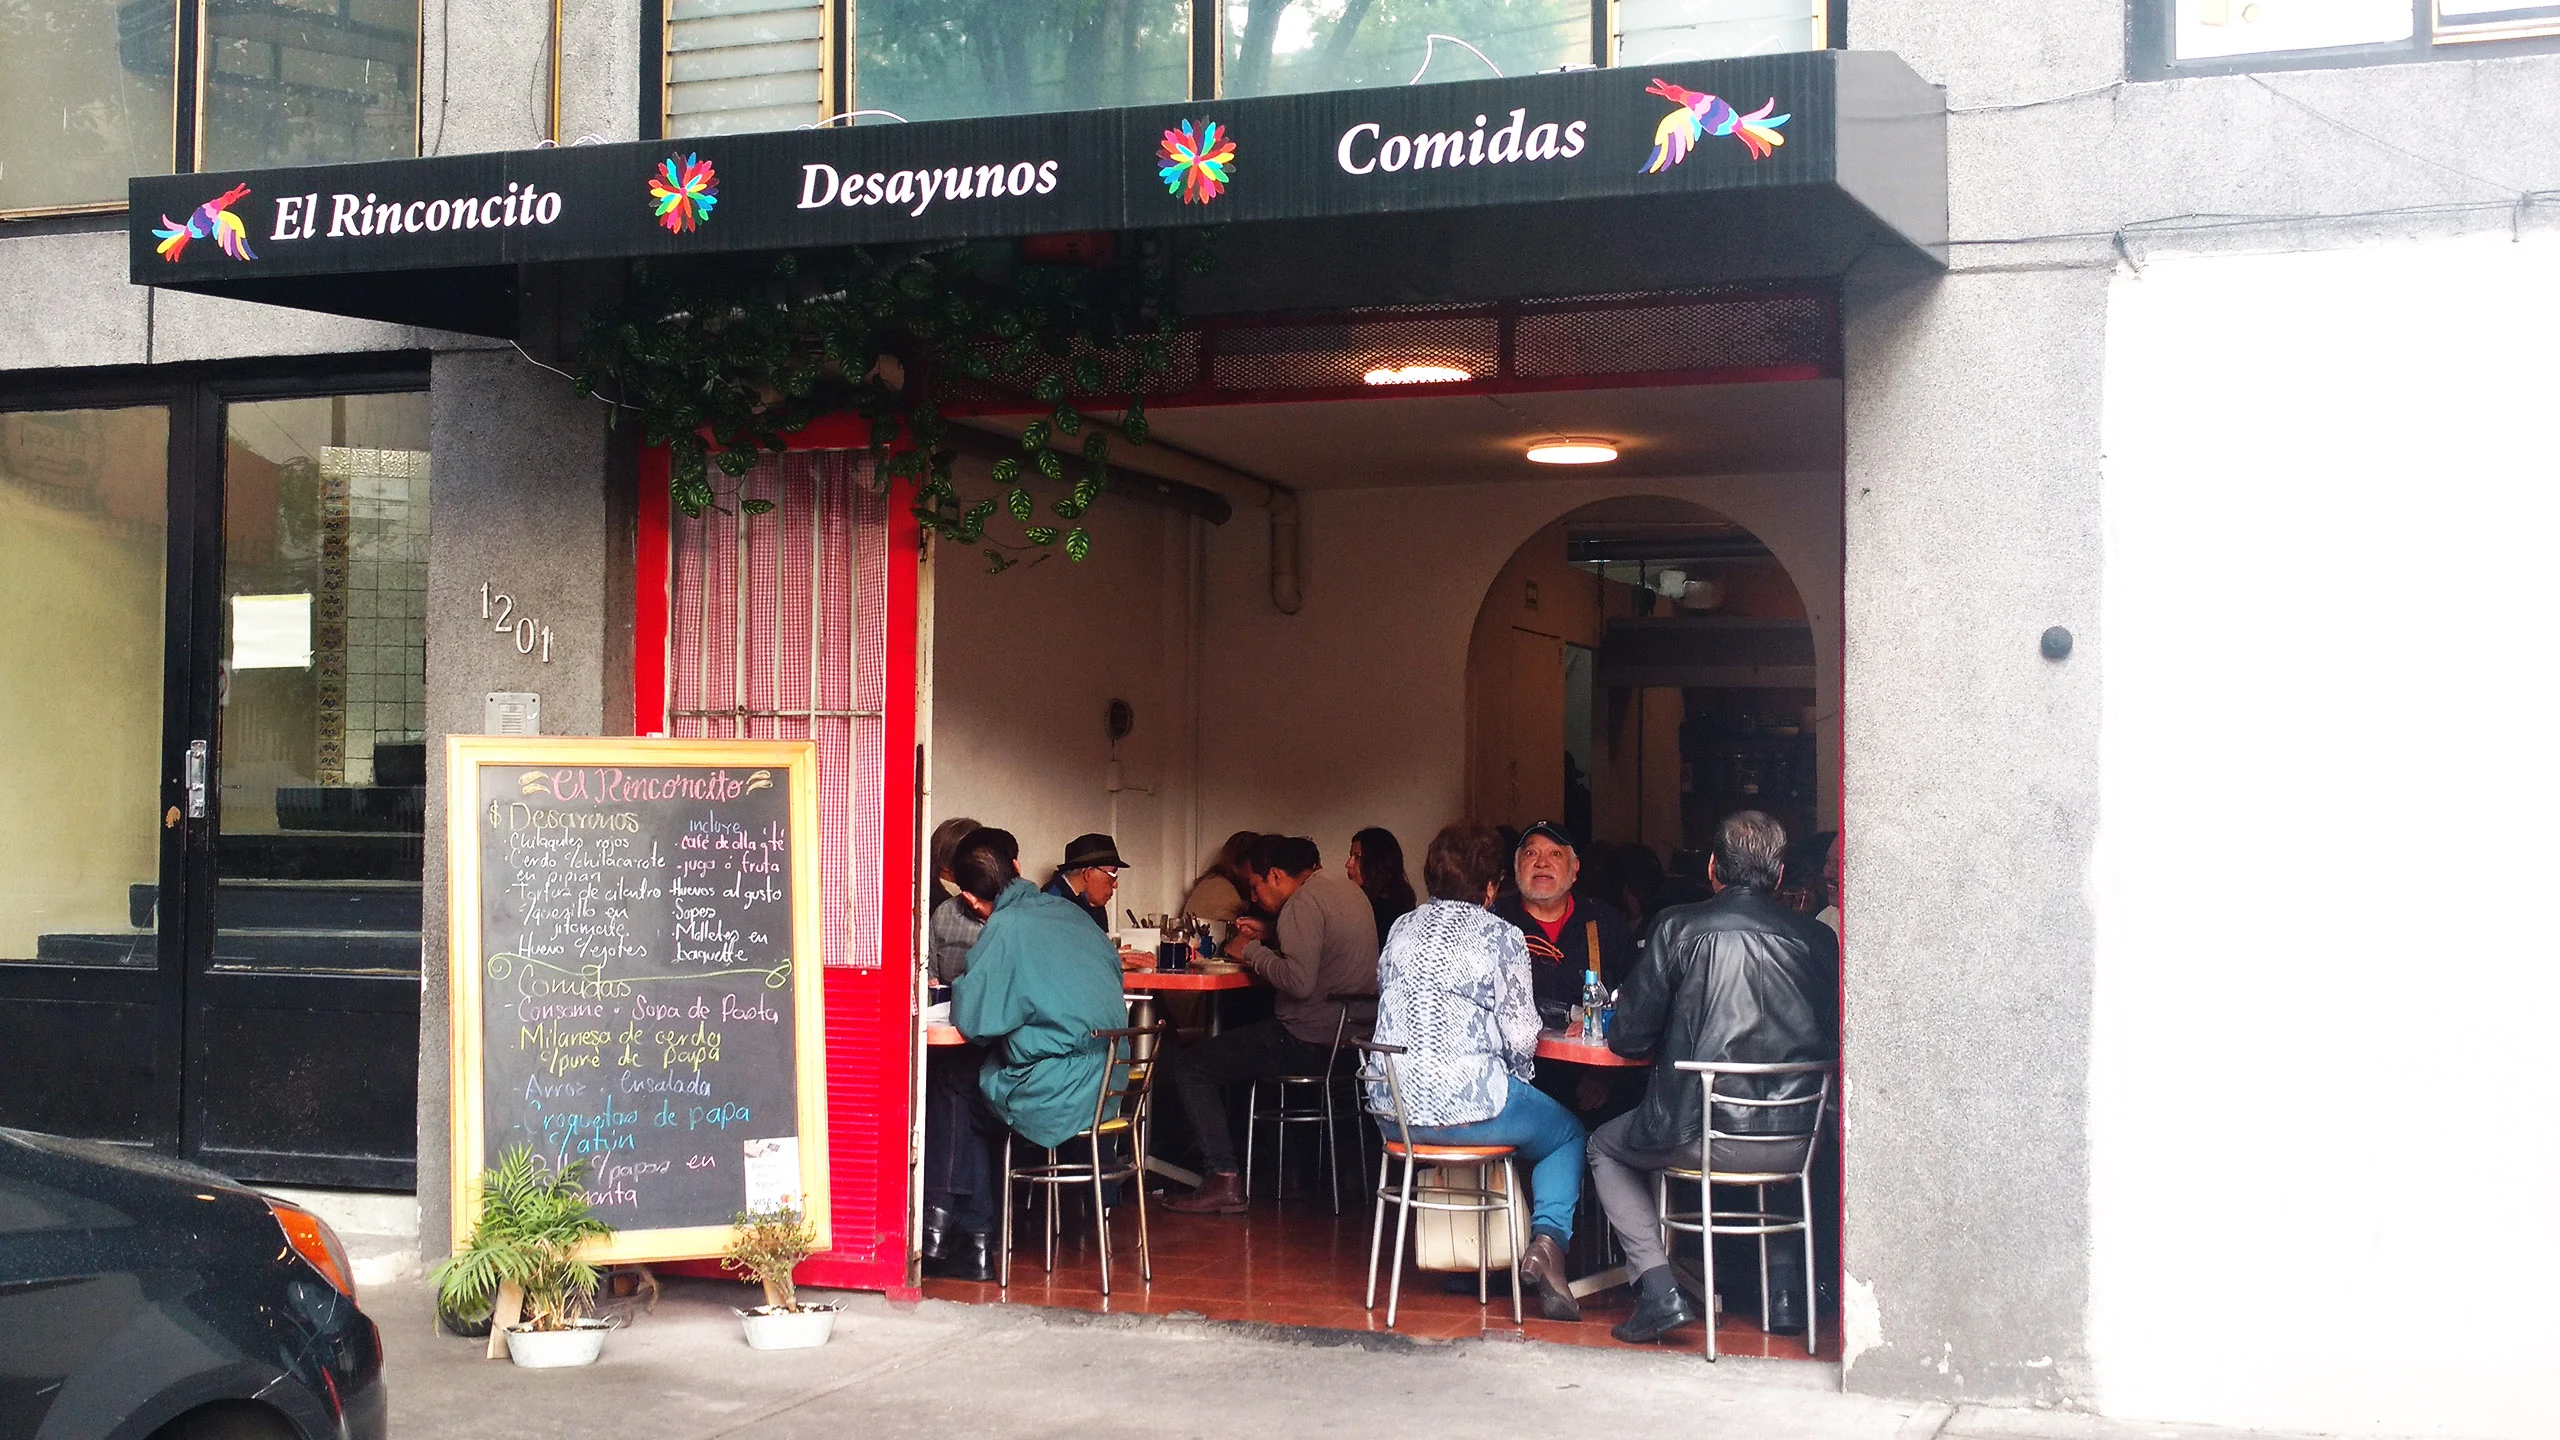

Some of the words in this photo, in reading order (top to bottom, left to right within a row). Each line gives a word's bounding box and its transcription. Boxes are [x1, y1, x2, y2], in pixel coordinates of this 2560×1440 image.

[1338, 108, 1587, 175] Comidas
[797, 160, 1058, 217] Desayunos
[270, 193, 317, 240] El
[326, 181, 562, 238] Rinconcito
[480, 582, 553, 663] 1201
[551, 769, 588, 801] El
[595, 768, 743, 803] Rinconcito
[596, 836, 630, 857] rojos
[681, 834, 709, 850] café
[715, 834, 730, 850] de
[731, 830, 757, 850] olla
[510, 848, 557, 869] Cerdo
[741, 850, 780, 874] fruta
[516, 869, 536, 881] en
[578, 882, 599, 900] de
[604, 876, 662, 901] cilantro
[671, 876, 716, 897] Huevos
[722, 870, 741, 898] al
[743, 875, 783, 910] gusto
[675, 897, 716, 922] Sopes
[518, 931, 564, 957] Huevo
[748, 932, 769, 944] en
[518, 963, 632, 1000] Comidas
[631, 994, 681, 1020] Sopa
[687, 996, 711, 1019] de
[519, 1020, 611, 1050] Milanesa
[618, 1021, 645, 1046] de
[617, 1044, 644, 1067] de
[525, 1073, 587, 1101] Arroz
[653, 1098, 678, 1128] de
[688, 1101, 750, 1131] papa
[685, 1154, 716, 1169] en
